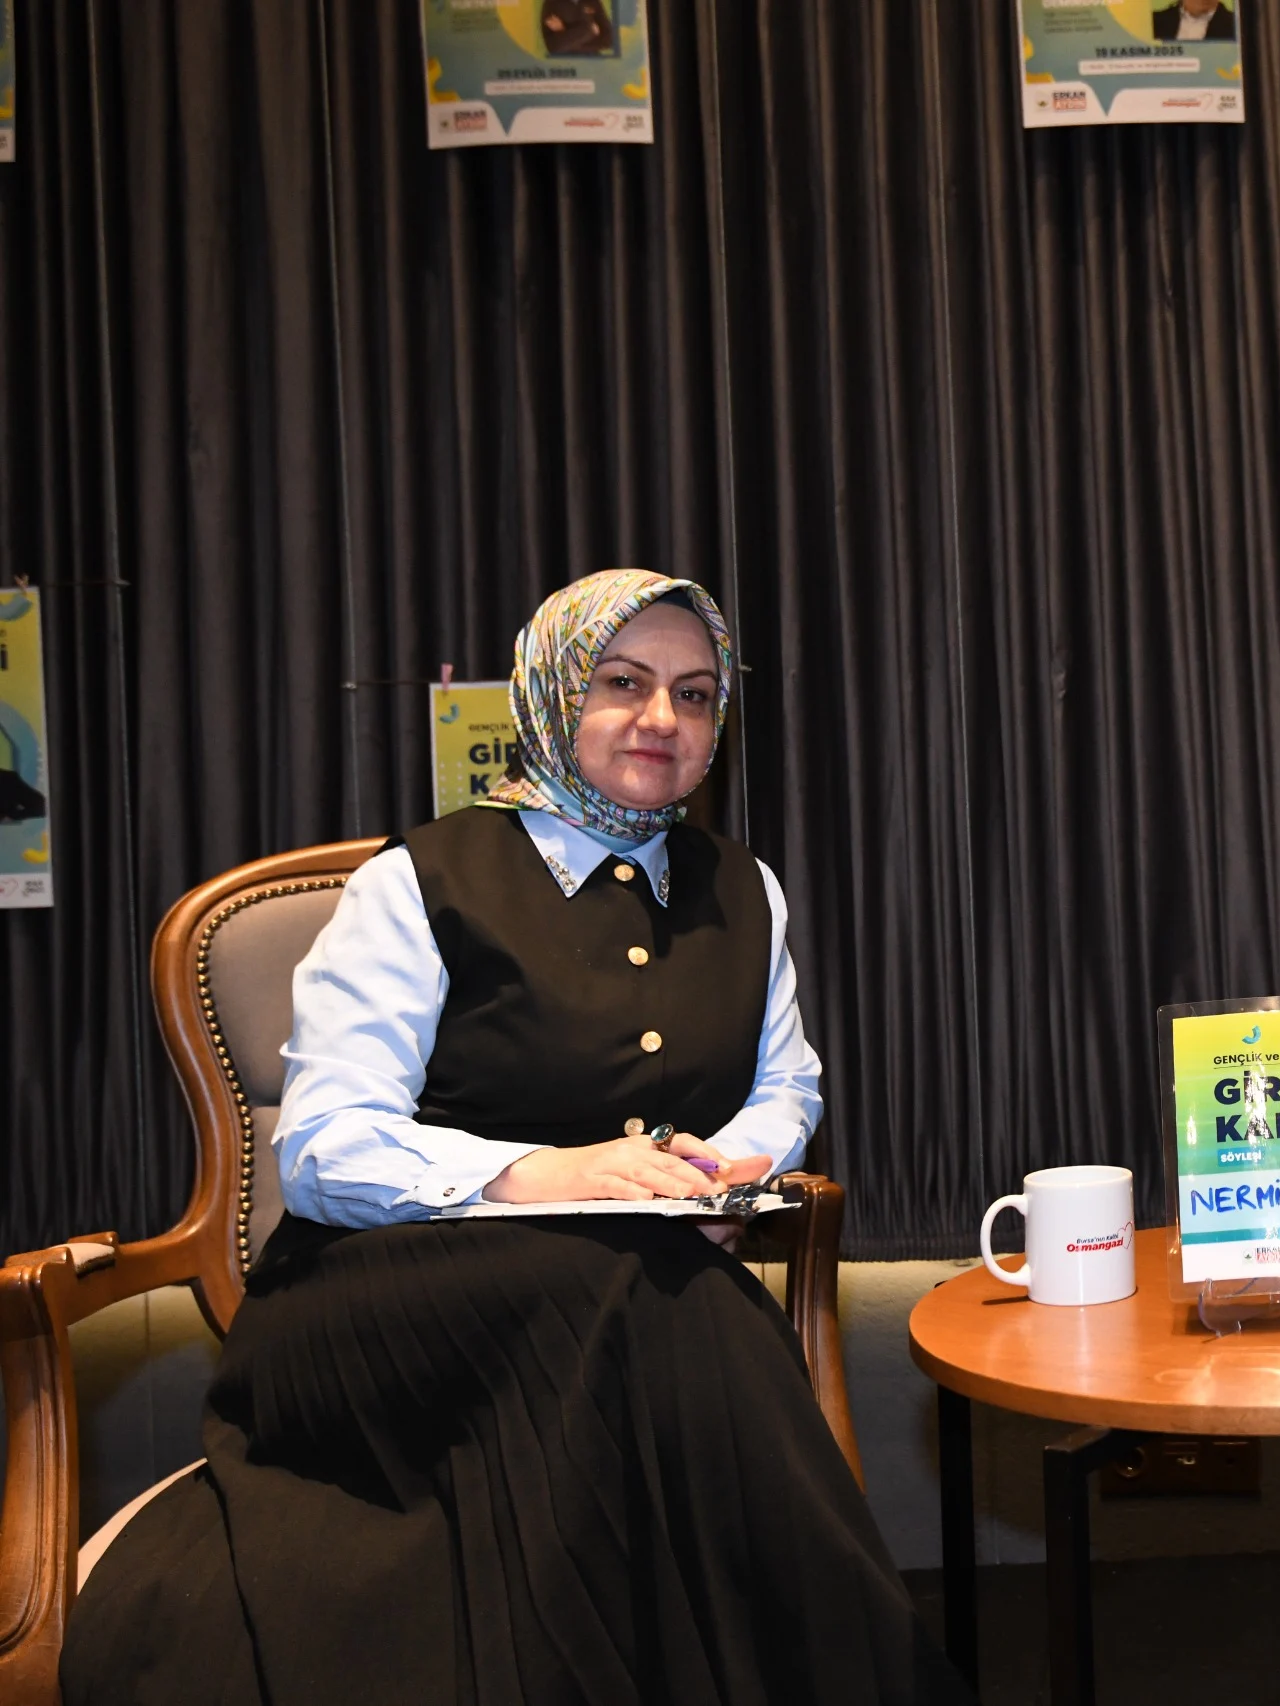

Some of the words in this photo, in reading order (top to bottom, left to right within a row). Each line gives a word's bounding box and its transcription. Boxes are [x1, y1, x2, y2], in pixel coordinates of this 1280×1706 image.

[1213, 1051, 1263, 1066] GENÇLİK
[1266, 1053, 1280, 1061] ve
[1066, 1237, 1124, 1253] Osmangazi
